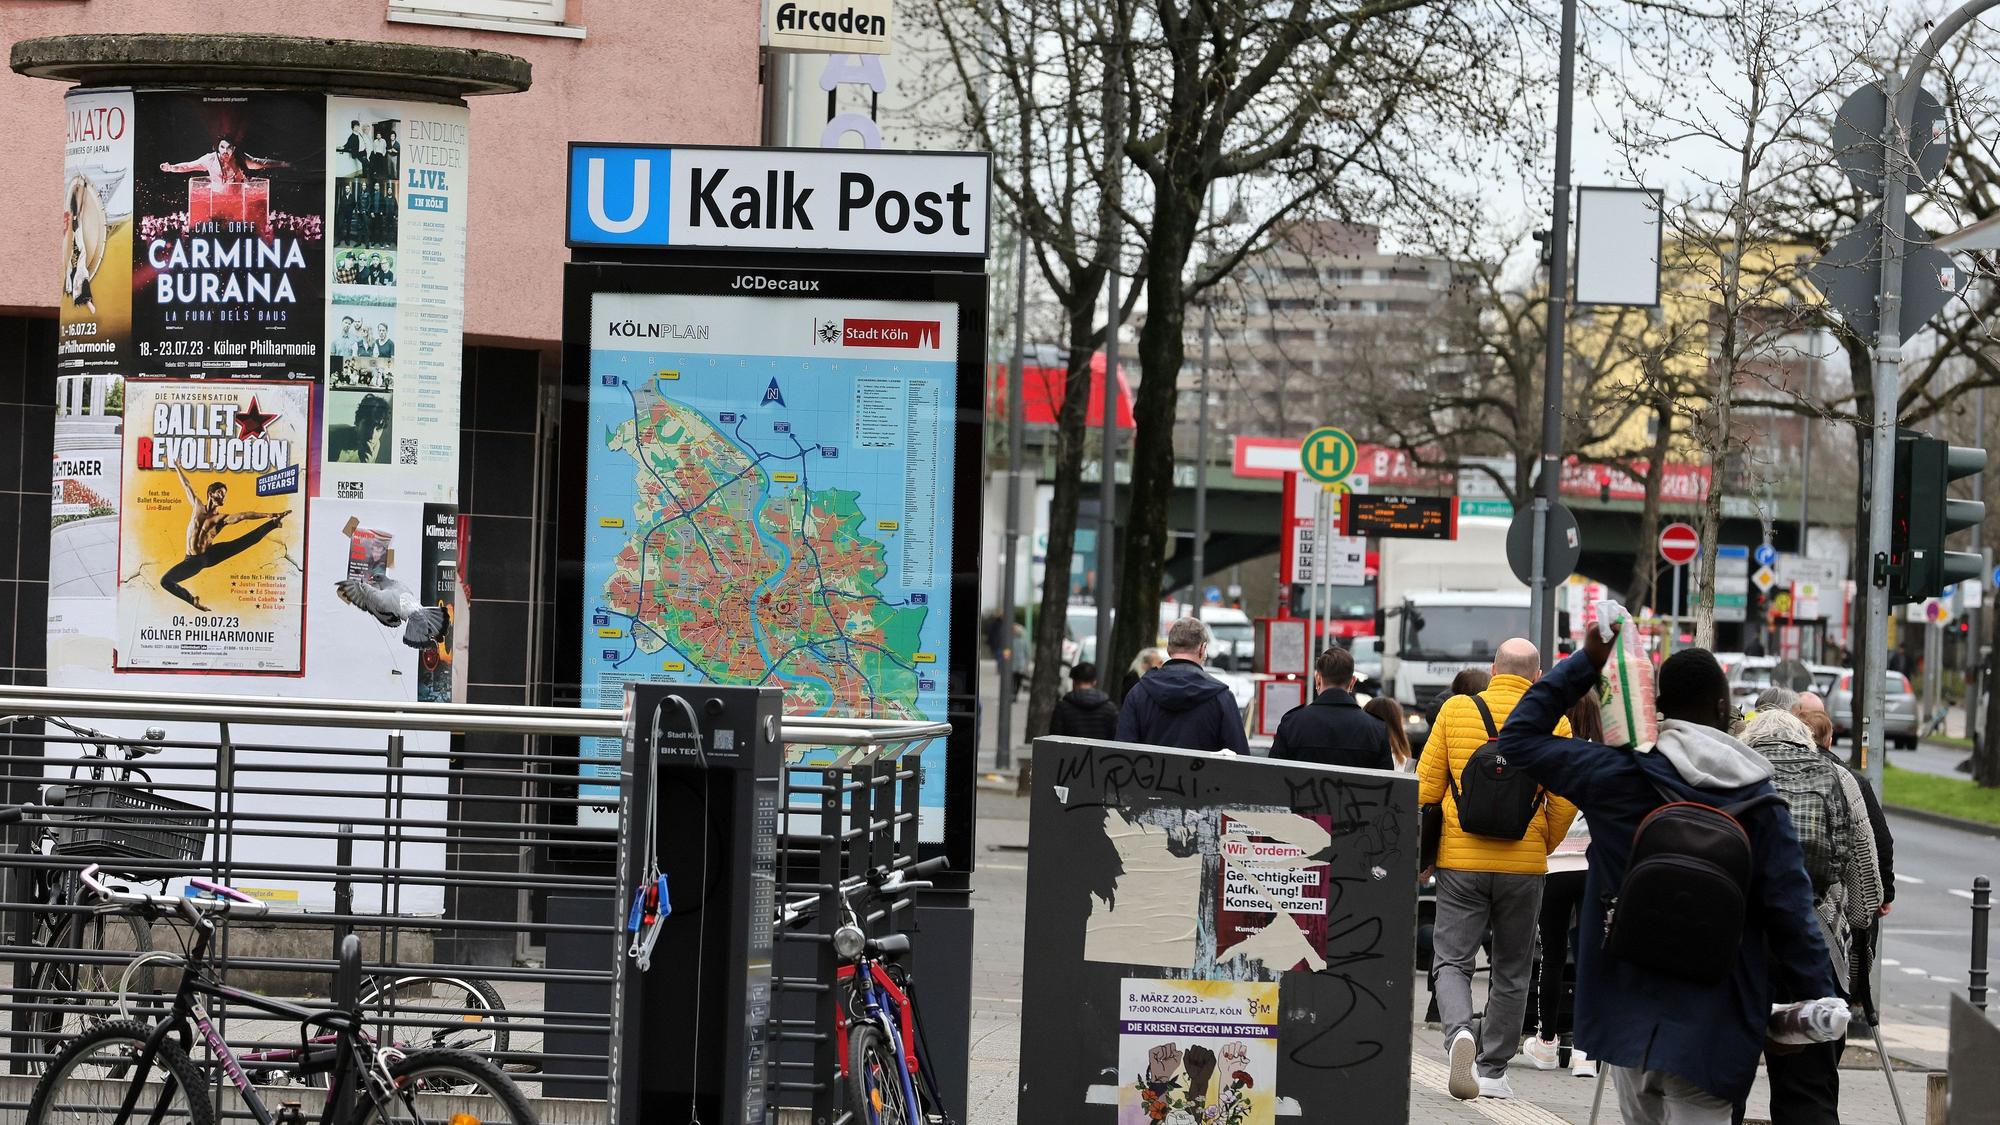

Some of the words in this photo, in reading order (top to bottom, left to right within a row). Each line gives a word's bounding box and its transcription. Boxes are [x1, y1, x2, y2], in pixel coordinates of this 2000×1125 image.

[776, 2, 886, 36] Arcaden
[410, 120, 466, 145] ENDLICH
[408, 144, 462, 168] WIEDER
[408, 168, 448, 191] LIVE.
[414, 198, 424, 208] IN
[425, 196, 444, 208] KÖLN
[588, 158, 651, 234] U
[689, 167, 815, 231] Kalk
[838, 172, 971, 237] Post
[195, 222, 220, 233] CARL
[228, 222, 256, 233] ORFF
[148, 238, 307, 269] CARMINA
[157, 272, 297, 304] BURANA
[731, 275, 820, 292] JCDecaux
[166, 311, 177, 322] LA
[186, 310, 212, 321] FURA
[220, 310, 249, 321] DELS
[258, 310, 286, 321] BAUS
[608, 320, 710, 340] KÖLNPLAN
[846, 327, 878, 340] Stadt
[880, 327, 909, 341] Köln
[214, 340, 247, 356] Kölner
[250, 340, 316, 356] Philharmonie
[155, 392, 168, 400] DIE
[171, 393, 238, 402] TANZSENSATION
[767, 388, 778, 400] N
[153, 403, 239, 436] BALLET
[138, 432, 289, 472] REVOLUCIÓN
[1316, 442, 1342, 471] H
[258, 469, 296, 485] CELEBRATING
[258, 484, 267, 492] 10
[267, 476, 296, 491] YEARS!
[338, 482, 350, 490] FKP
[338, 490, 364, 500] SCORPIO
[437, 514, 448, 524] Wer
[426, 525, 444, 536] Klima
[140, 626, 182, 641] KÖLNER
[185, 629, 275, 643] PHILHARMONIE
[667, 730, 686, 738] Stadt
[1227, 844, 1248, 855] Wir
[1226, 871, 1316, 884] Gechtigkeit!
[1226, 884, 1299, 898] Aufkrung!
[1225, 896, 1323, 911] Konseqenzen!
[1129, 994, 1138, 1002] 8.
[1141, 992, 1170, 1003] MÄRZ
[1173, 995, 1198, 1004] 2023
[1152, 1006, 1218, 1015] RONCALLIPLATZ,
[1220, 1007, 1242, 1016] KÖLN
[1128, 1023, 1142, 1032] DIE
[1144, 1023, 1177, 1032] KRISEN
[1179, 1025, 1219, 1034] STECKEN
[1233, 1027, 1268, 1036] SYSTEM
